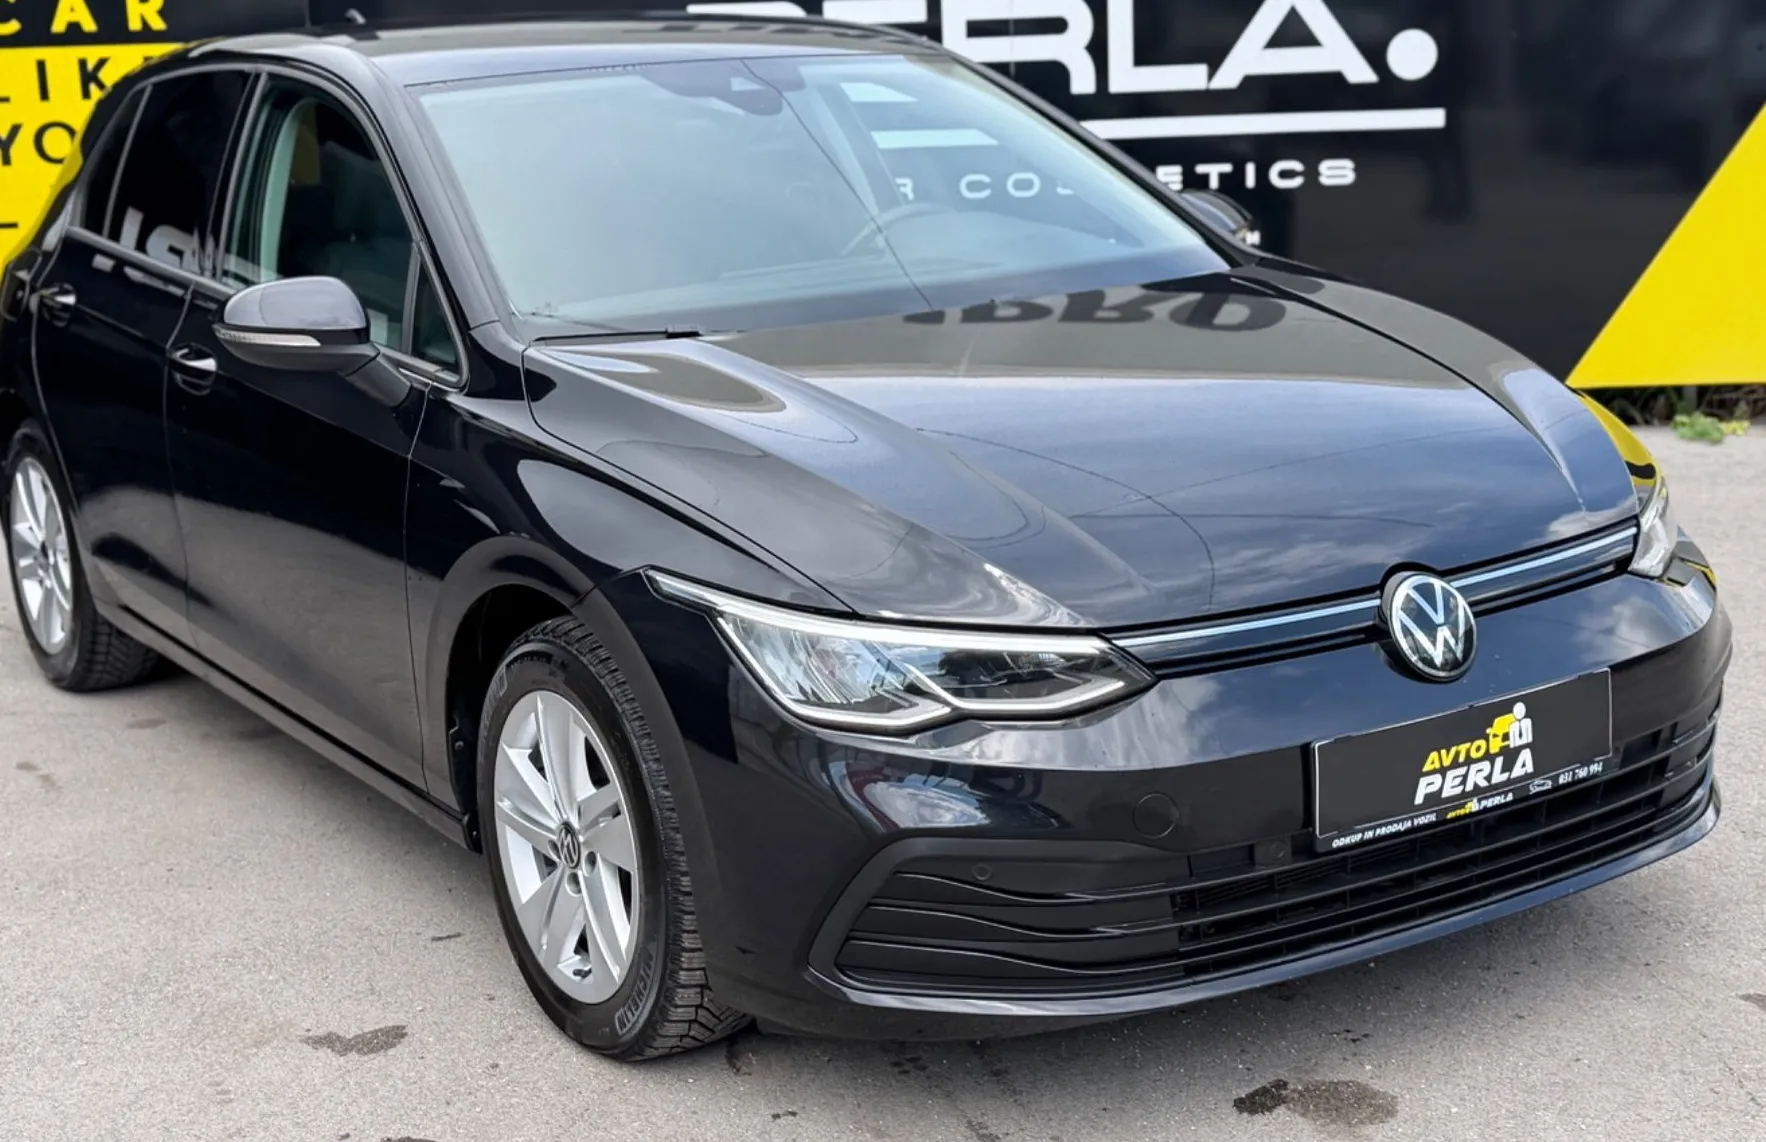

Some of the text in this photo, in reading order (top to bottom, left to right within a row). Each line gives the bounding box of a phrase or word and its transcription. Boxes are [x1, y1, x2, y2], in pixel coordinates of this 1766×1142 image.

[1414, 748, 1534, 805] PERLA
[1422, 739, 1488, 772] AVTO
[1332, 832, 1363, 848] ODKUP
[1364, 829, 1375, 840] IN
[1375, 820, 1412, 837] PRODAJA
[1478, 792, 1514, 811] PERLA
